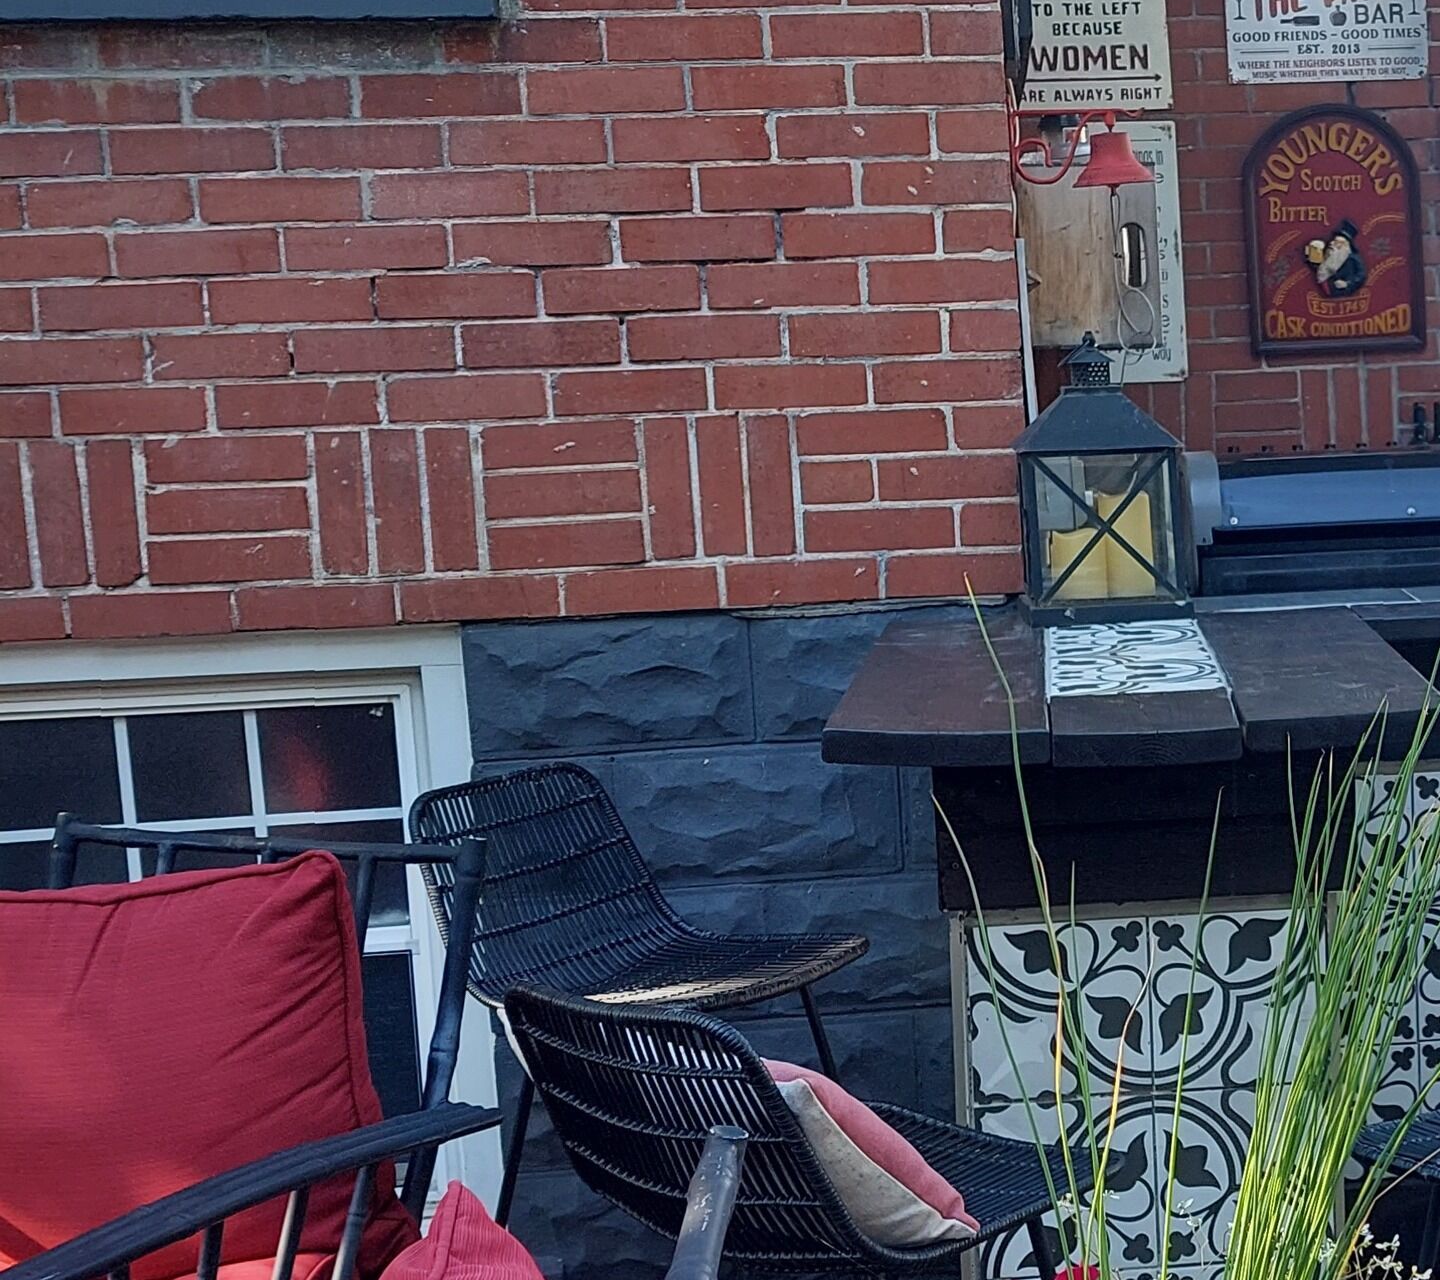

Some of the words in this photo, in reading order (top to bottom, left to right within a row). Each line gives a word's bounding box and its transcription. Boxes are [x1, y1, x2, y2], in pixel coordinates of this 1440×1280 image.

[1032, 3, 1053, 17] TO
[1062, 2, 1093, 16] THE
[1102, 1, 1141, 16] LEFT
[1354, 3, 1404, 25] BAR
[1052, 21, 1123, 36] BECAUSE
[1232, 32, 1271, 43] GOOD
[1274, 30, 1327, 42] FRIENDS
[1341, 28, 1379, 40] GOOD
[1382, 27, 1421, 39] TIMES
[1297, 44, 1325, 55] EST.
[1331, 43, 1361, 54] 2013
[1030, 44, 1149, 72] WOMEN
[1237, 61, 1271, 69] WHERE
[1272, 60, 1291, 68] THE
[1293, 58, 1345, 68] NEIGHBORS
[1347, 57, 1377, 67] LISTEN
[1379, 56, 1392, 65] TO
[1394, 56, 1420, 65] GOOD
[1252, 70, 1277, 79] MUSIC
[1279, 69, 1318, 78] WHETHER
[1021, 89, 1046, 103] ARE
[1054, 88, 1114, 102] ALWAYS
[1120, 87, 1163, 101] RIGHT
[1259, 122, 1403, 197] YOUNGER'S
[1311, 299, 1334, 315] EST
[1265, 309, 1307, 339] CASK
[1310, 303, 1411, 337] CONDITIONED
